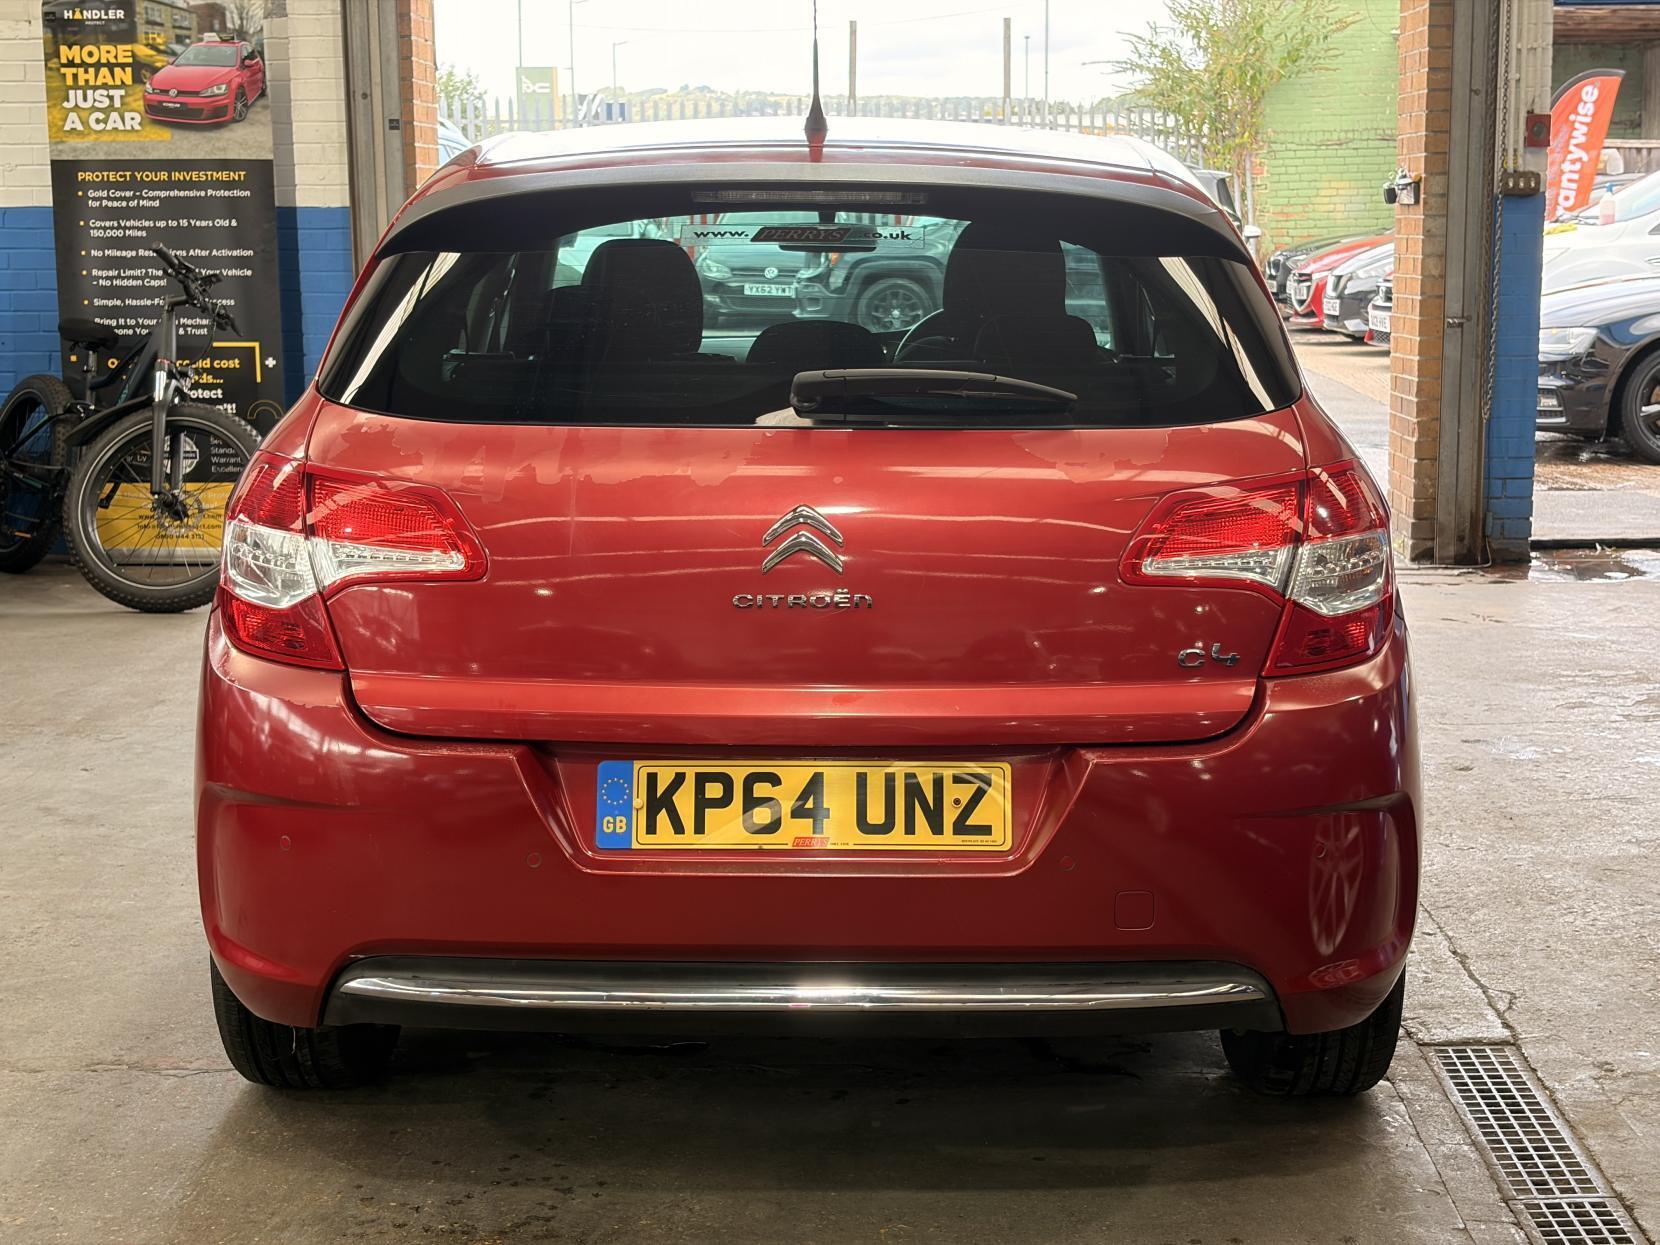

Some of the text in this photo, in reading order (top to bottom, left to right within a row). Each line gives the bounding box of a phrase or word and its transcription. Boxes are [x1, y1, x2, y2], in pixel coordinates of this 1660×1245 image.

[60, 45, 133, 64] MORE
[60, 67, 133, 86] THAN
[62, 89, 125, 109] JUST
[63, 111, 142, 131] A CAR
[78, 171, 247, 181] PROTECT YOUR INVESTMENT
[87, 189, 108, 198] Gold
[109, 189, 134, 198] Cover
[142, 189, 206, 199] Comprehensive
[207, 188, 251, 198] Protection
[88, 199, 160, 208] for Peace of Mind
[89, 219, 238, 229] Covers Vehicles up to 15 Years Old &
[89, 229, 147, 238] 150,000 Miles
[91, 249, 103, 257] No
[104, 248, 137, 258] Mileage
[188, 248, 210, 257] After
[211, 248, 254, 257] Activation
[92, 268, 118, 277] Repair
[120, 268, 146, 277] Limit?
[147, 268, 163, 277] The
[221, 268, 253, 277] Vehicle
[98, 279, 112, 287] No
[113, 278, 143, 287] Hidden
[143, 278, 168, 288] Caps!
[93, 297, 124, 308] Simple,
[118, 317, 125, 326] It
[126, 317, 136, 326] to
[137, 317, 158, 326] Your
[178, 327, 185, 336] &
[186, 327, 209, 336] Trust
[213, 358, 240, 369] cost
[190, 388, 223, 399] otect
[210, 456, 241, 464] Warrant
[1178, 642, 1240, 666] C4
[645, 771, 993, 836] KP64 UNZ
[602, 815, 627, 833] GB
